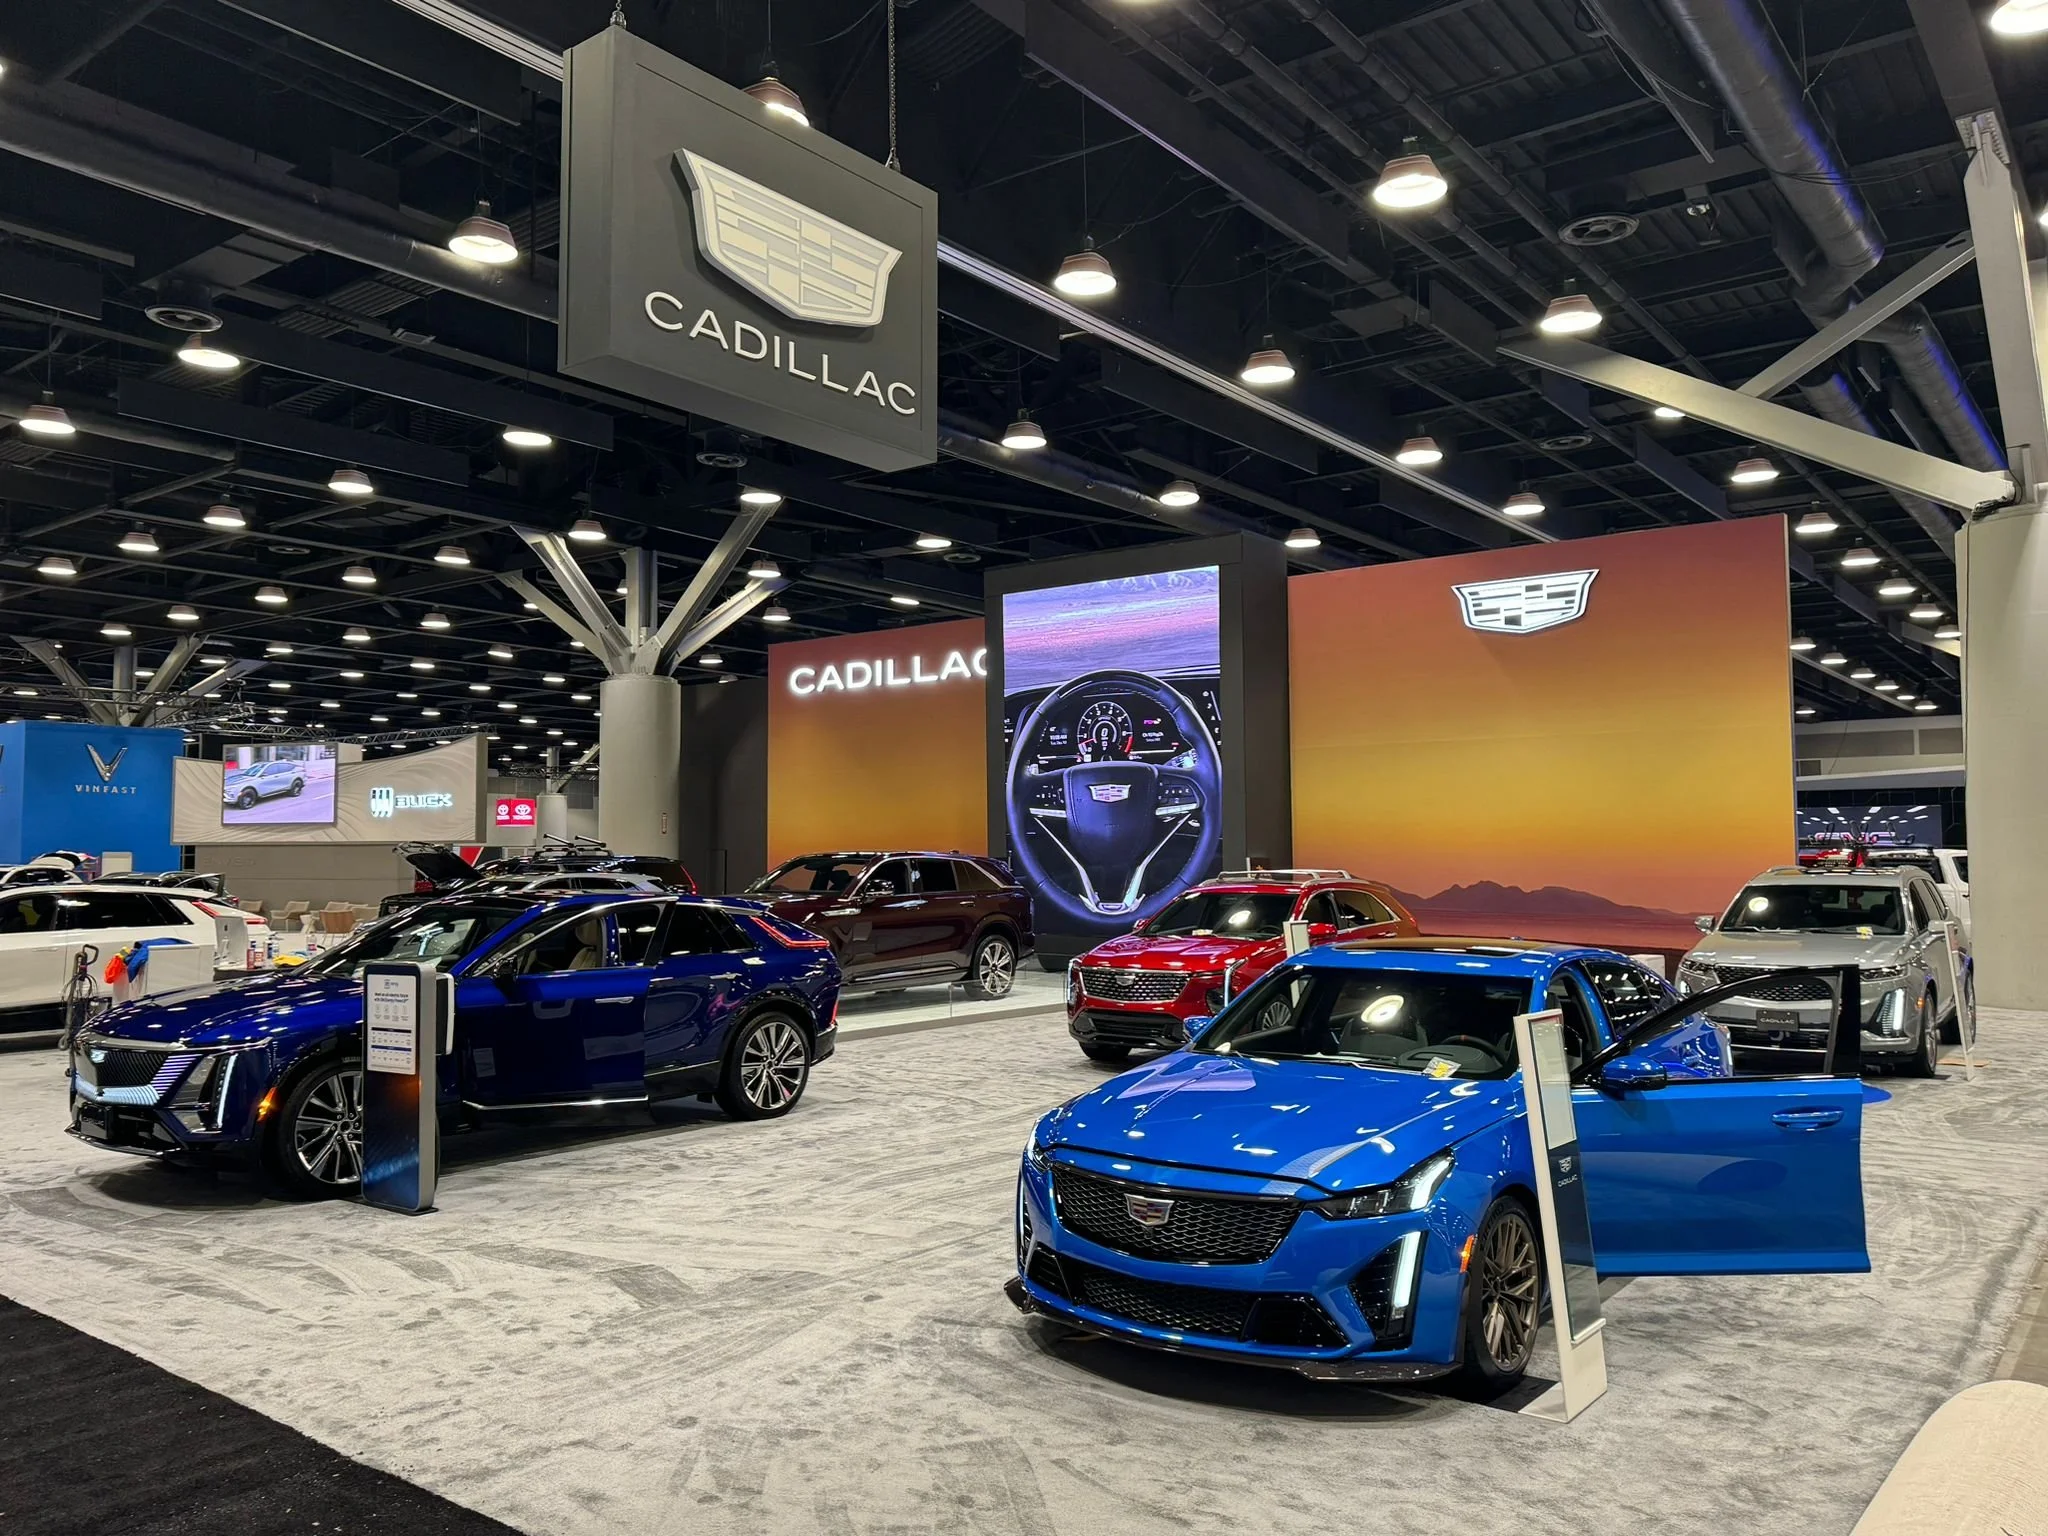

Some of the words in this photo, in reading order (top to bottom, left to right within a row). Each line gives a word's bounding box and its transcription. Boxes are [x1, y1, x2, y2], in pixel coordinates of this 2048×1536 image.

[643, 290, 917, 416] CADILLAC
[74, 784, 137, 795] VINFAST
[394, 793, 454, 809] BUICK
[1760, 1017, 1795, 1025] CADILLAC
